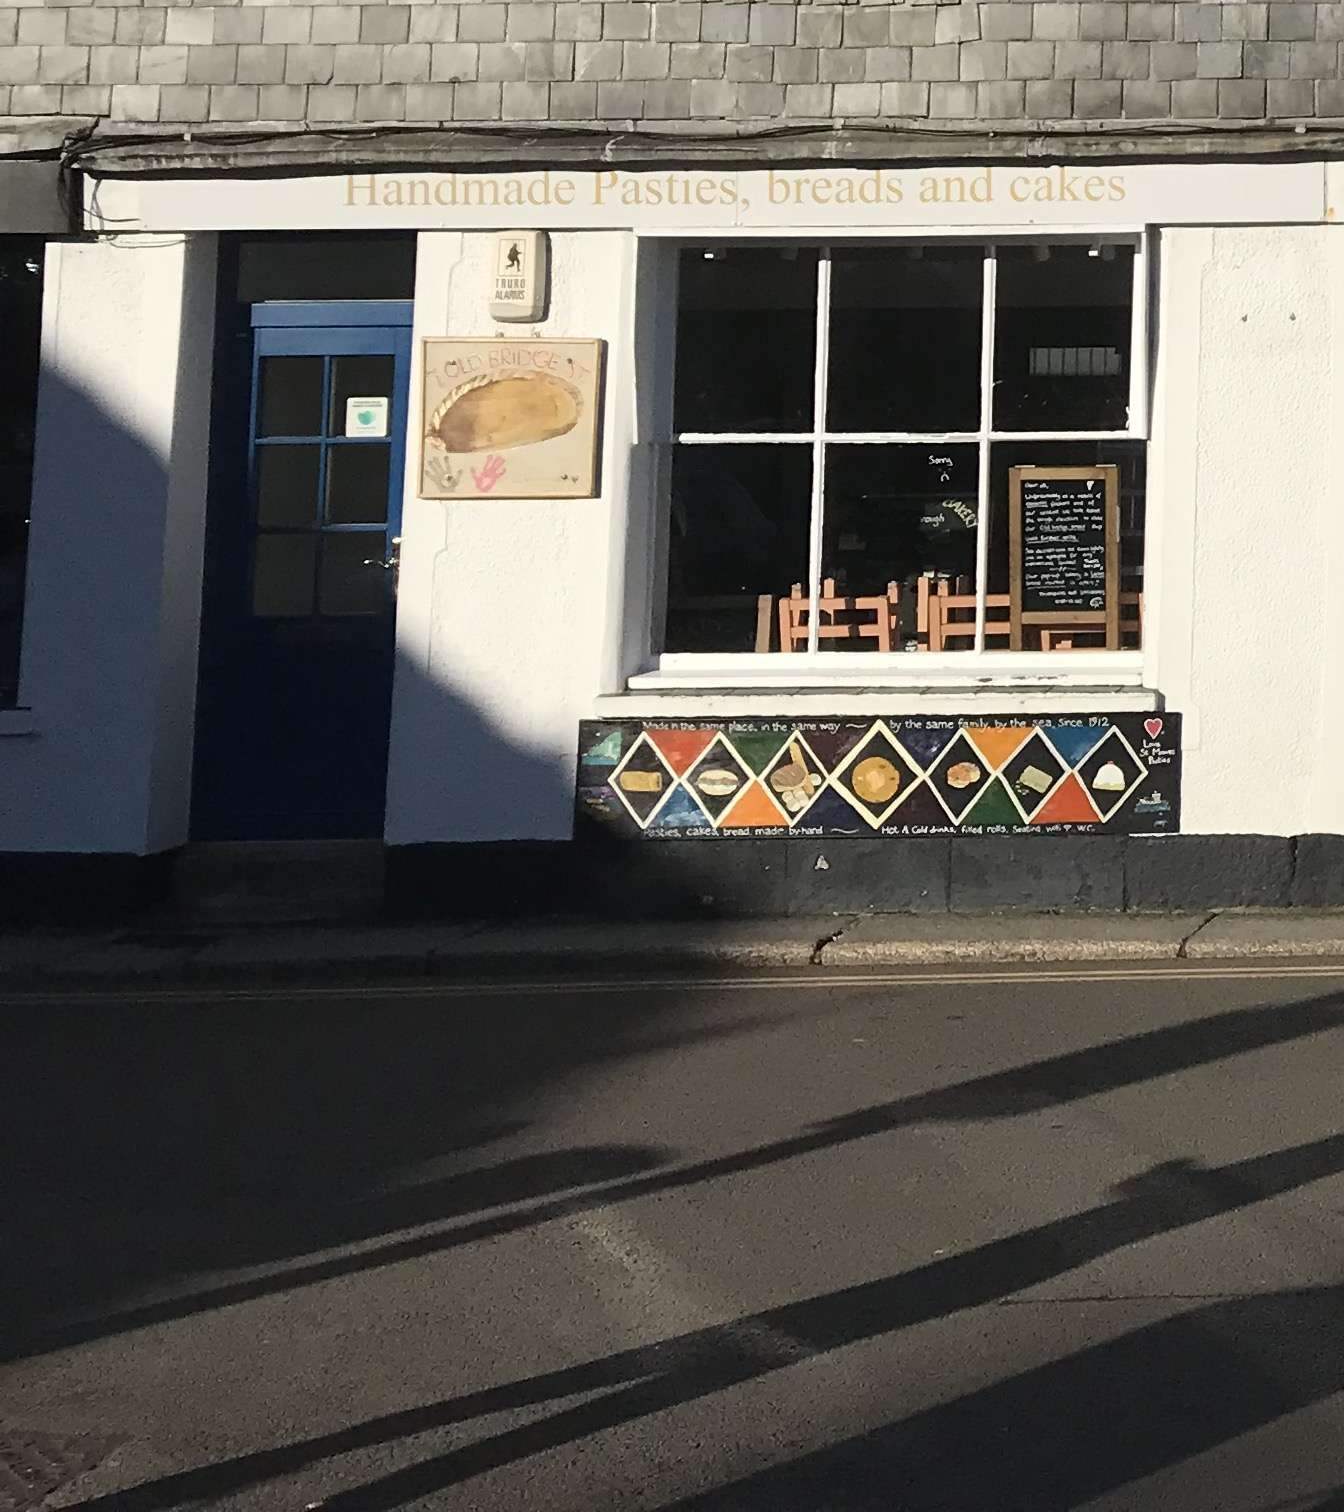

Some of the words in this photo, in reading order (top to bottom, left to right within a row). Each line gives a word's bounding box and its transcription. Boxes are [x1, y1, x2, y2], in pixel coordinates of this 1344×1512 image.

[345, 172, 577, 206] Handmade
[592, 170, 752, 211] Pasties,
[767, 169, 904, 205] breads
[918, 167, 994, 204] and
[1008, 166, 1127, 202] cakes
[496, 278, 526, 288] TRURO
[488, 347, 561, 371] BRIDGE
[772, 721, 788, 731] the
[791, 722, 817, 731] same
[820, 723, 841, 734] way
[889, 719, 902, 733] by
[905, 719, 922, 729] the
[925, 720, 954, 729] same
[994, 719, 1007, 732] by
[1010, 718, 1027, 728] the
[1088, 715, 1110, 728] 1912
[755, 826, 785, 836] made
[881, 826, 899, 834] Hot
[911, 825, 928, 834] Cold
